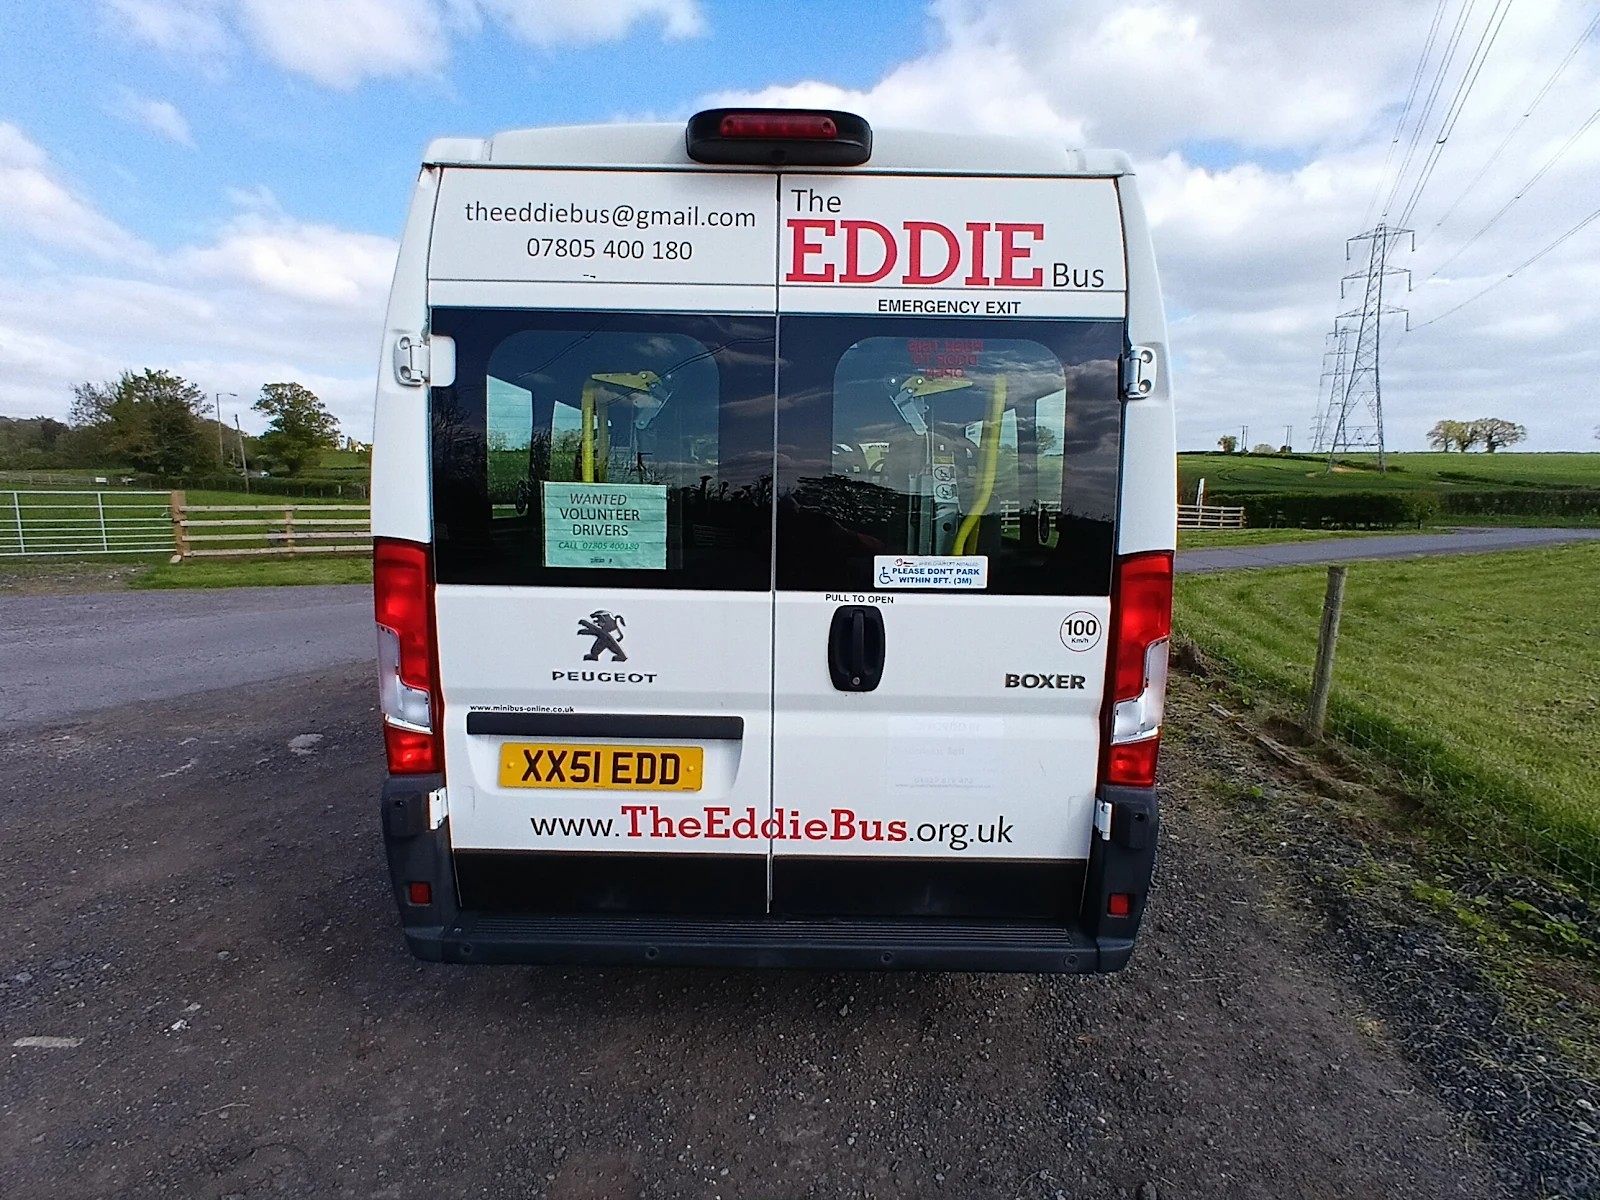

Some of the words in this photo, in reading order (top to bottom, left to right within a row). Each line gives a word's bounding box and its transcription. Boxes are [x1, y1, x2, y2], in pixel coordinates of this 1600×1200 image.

[790, 189, 841, 213] The
[465, 201, 756, 229] theeddiebus@gmail.com
[526, 238, 596, 258] 07805
[603, 240, 644, 259] 400
[652, 241, 692, 261] 180
[786, 218, 1045, 287] EDDIE
[1052, 262, 1105, 288] Bus
[878, 299, 980, 315] EMERGENCY
[986, 301, 1021, 315] EXIT
[570, 493, 627, 505] WANTED
[560, 507, 640, 521] VOLUNTEER
[572, 524, 629, 536] DRIVERS
[558, 541, 578, 549] CALL
[582, 541, 607, 550] 07805
[892, 567, 925, 575] PLEASE
[956, 568, 980, 576] PARK
[898, 576, 931, 584] WITHIN
[953, 577, 972, 586] (3M)
[825, 593, 849, 602] PULL
[852, 594, 865, 603] TO
[867, 595, 894, 604] OPEN
[1064, 619, 1097, 636] 100
[551, 671, 657, 684] PEUGEOT
[1004, 673, 1086, 689] BOXER
[470, 704, 575, 713] www.minibus-online.co.uk
[522, 749, 602, 784] XX51
[612, 751, 681, 785] EDD
[530, 805, 1014, 850] www.TheEddieBus.org.uk
